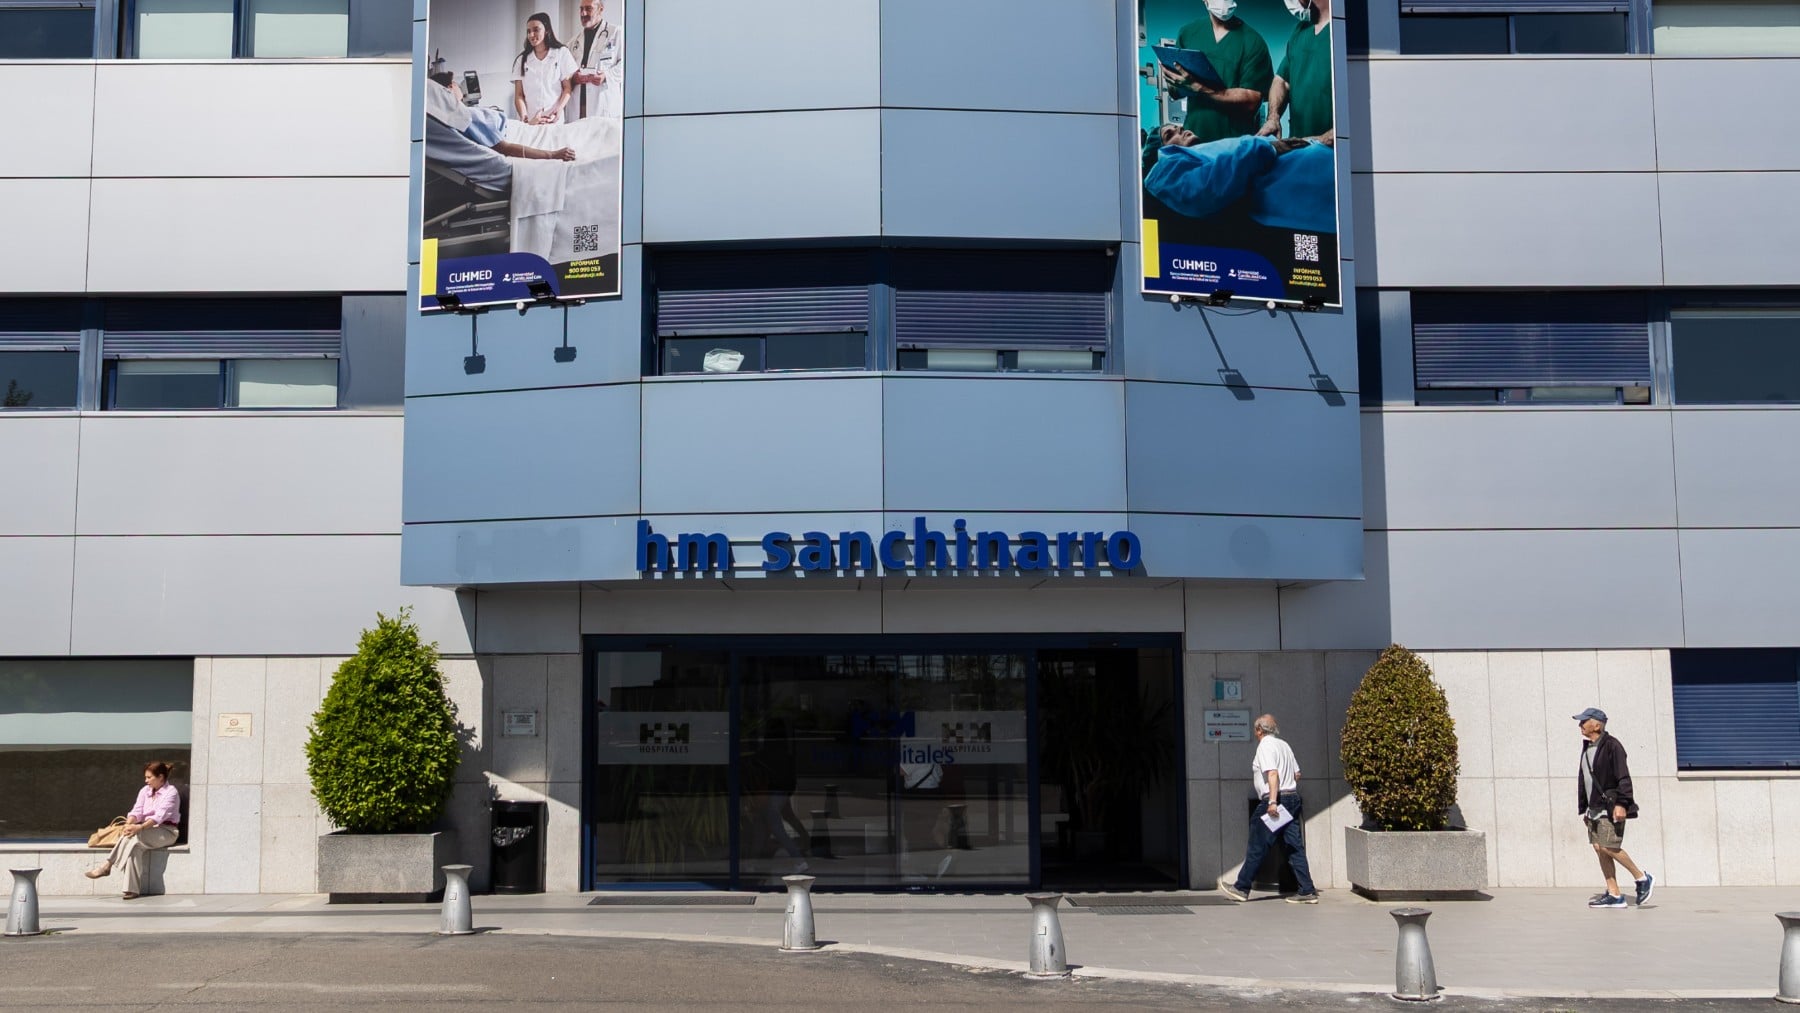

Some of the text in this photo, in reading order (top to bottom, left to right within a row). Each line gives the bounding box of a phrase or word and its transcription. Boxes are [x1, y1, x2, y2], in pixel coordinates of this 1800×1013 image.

[1172, 258, 1217, 272] CUHMED
[449, 269, 492, 283] CUHMED
[637, 517, 1142, 572] hm sanchinarro
[639, 745, 689, 753] HOSPITALES
[942, 745, 992, 753] HOSPITALES
